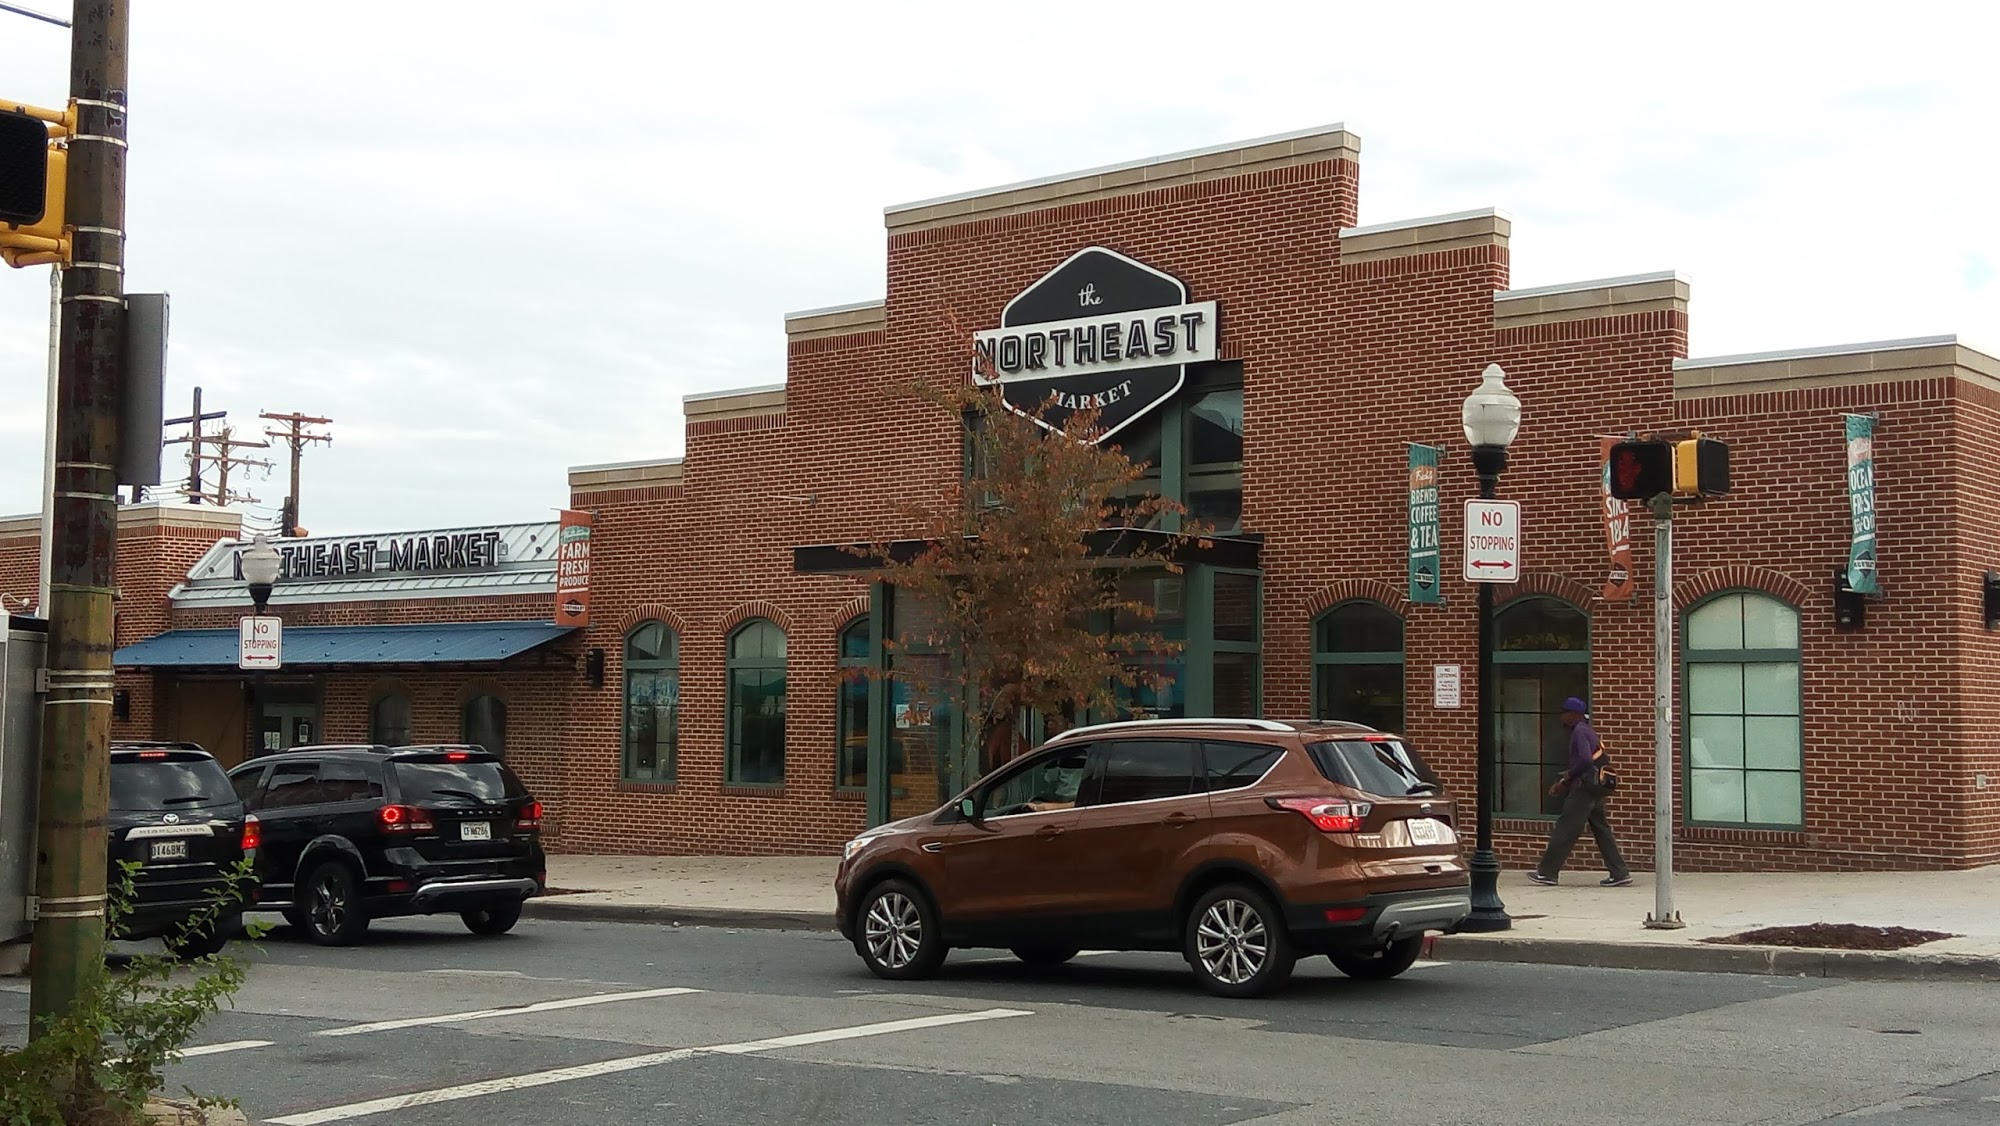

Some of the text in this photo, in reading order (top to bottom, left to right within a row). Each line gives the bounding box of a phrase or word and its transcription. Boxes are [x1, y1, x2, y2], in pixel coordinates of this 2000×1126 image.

[1078, 283, 1103, 307] the
[975, 312, 1204, 374] NORTHEAST
[1050, 380, 1132, 409] MARKET
[1411, 488, 1437, 504] BREWED
[1411, 505, 1437, 524] COFFEE
[1481, 511, 1503, 527] NO
[1410, 525, 1438, 549] & TEA
[1470, 535, 1514, 551] STOPPING
[389, 532, 500, 571] MARKET
[561, 542, 590, 560] FARM
[560, 560, 590, 576] FRESH
[559, 575, 589, 588] PRODUCE
[253, 624, 269, 635] NO
[244, 639, 277, 650] STOPPING
